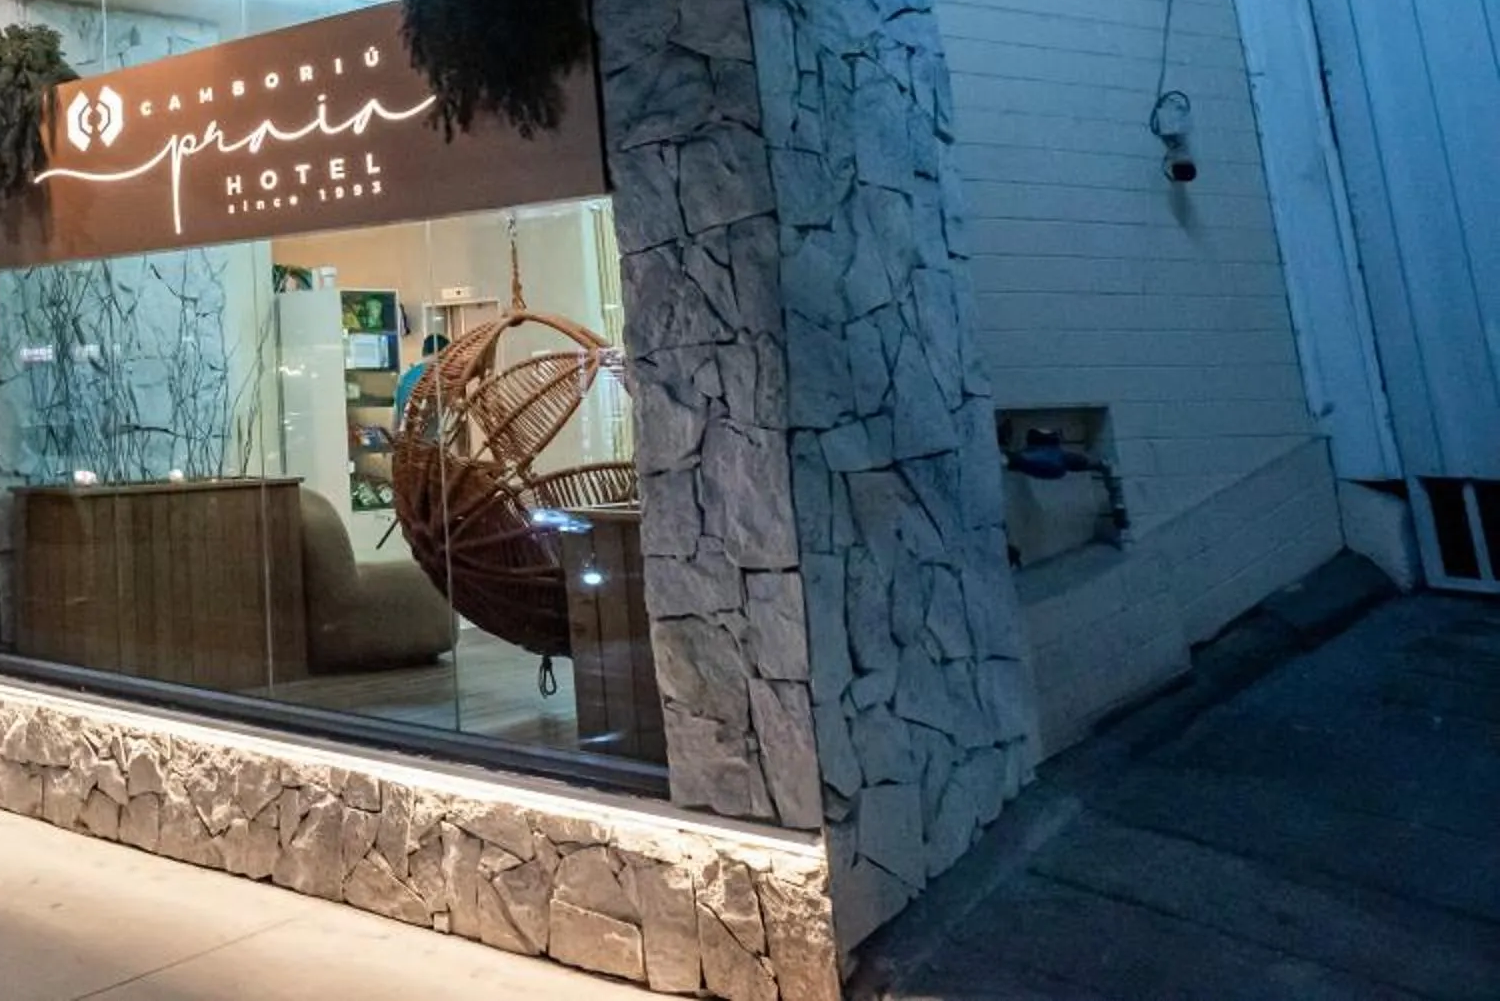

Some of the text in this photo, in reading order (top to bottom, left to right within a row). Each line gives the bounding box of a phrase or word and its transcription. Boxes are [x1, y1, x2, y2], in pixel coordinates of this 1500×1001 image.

[140, 46, 381, 116] CAMBORIÚ
[226, 152, 382, 196] HOTEL
[227, 181, 383, 214] since 1993
